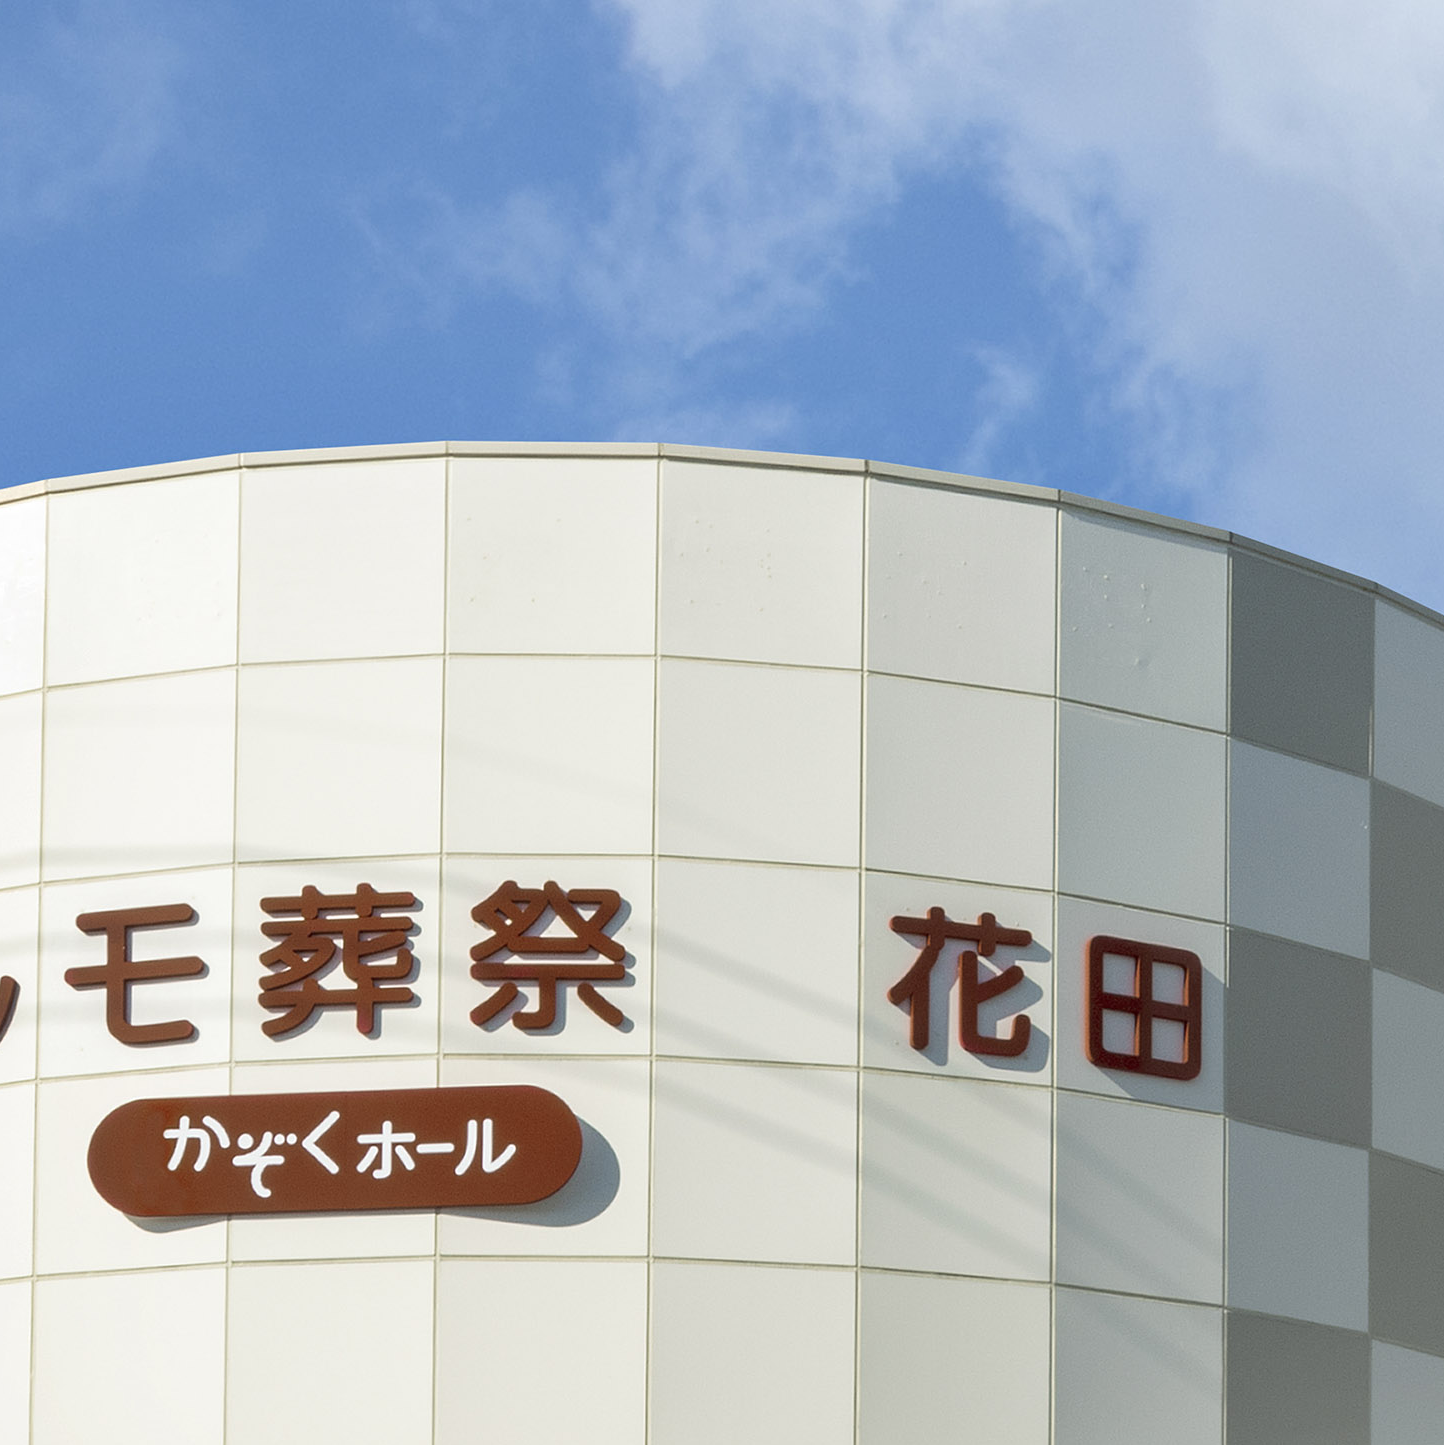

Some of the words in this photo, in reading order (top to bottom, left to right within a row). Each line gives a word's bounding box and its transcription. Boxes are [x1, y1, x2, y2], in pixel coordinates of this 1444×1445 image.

[885, 905, 1203, 1082] 花田
[161, 1112, 517, 1200] かぞくホール
